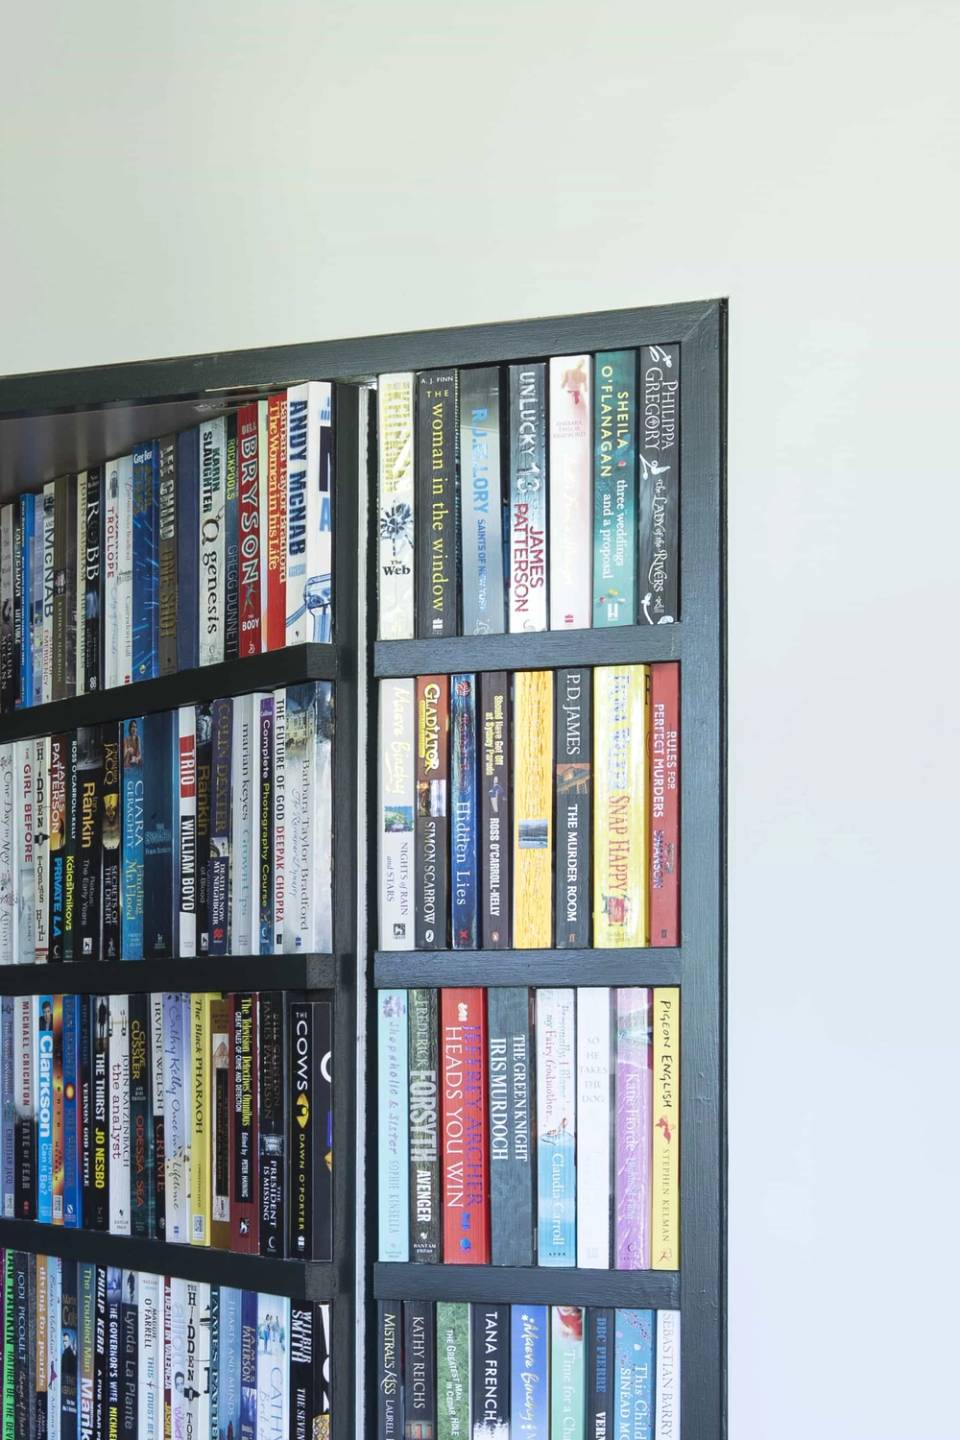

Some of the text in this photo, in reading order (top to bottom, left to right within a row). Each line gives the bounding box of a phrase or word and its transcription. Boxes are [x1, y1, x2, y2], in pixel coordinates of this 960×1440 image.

[601, 366, 612, 477] O'FLANAGAN
[617, 392, 628, 448] SHEILA
[645, 368, 662, 450] GREGORY
[662, 381, 678, 450] PHILIPPA
[241, 435, 257, 585] BRYSON
[289, 400, 307, 555] ANDY McNAB
[432, 403, 448, 612] woman in the window
[203, 551, 221, 634] genesis
[514, 503, 528, 612] PATTERSON
[529, 526, 543, 587] JAMES
[181, 751, 195, 785] TRIO
[563, 704, 580, 754] JAMES
[654, 704, 664, 754] PERFECT
[81, 782, 96, 848] Rankin
[261, 719, 270, 907] Complete Photography Course
[275, 700, 285, 923] THE FUTURE OF GOD DEEPAK CHOPRA
[457, 801, 469, 865] Hidden
[653, 759, 664, 818] MURDERS
[181, 821, 195, 910] WILLIAM BOYD
[424, 821, 435, 924] SIMON SCARROW
[457, 871, 469, 905] Lies
[567, 804, 577, 921] THE MURDER ROOM
[39, 1035, 53, 1137] Clarkson
[95, 1053, 104, 1122] THE THIRST
[296, 1021, 307, 1090] COWS
[491, 1038, 508, 1160] IRIS MURDOCH
[513, 1035, 527, 1161] THE GREEN KNIGHT
[660, 1001, 672, 1108] PIGEON ENGLISH
[95, 1128, 104, 1145] JO
[410, 1070, 436, 1161] FORSYTH
[446, 1026, 463, 1207] HEADS YOU WIN
[416, 1170, 431, 1221] AVENGER
[124, 1311, 136, 1429] Lynda La Plante
[413, 1317, 425, 1408] KATHY REICHS
[485, 1312, 497, 1420] TANA FRENCH
